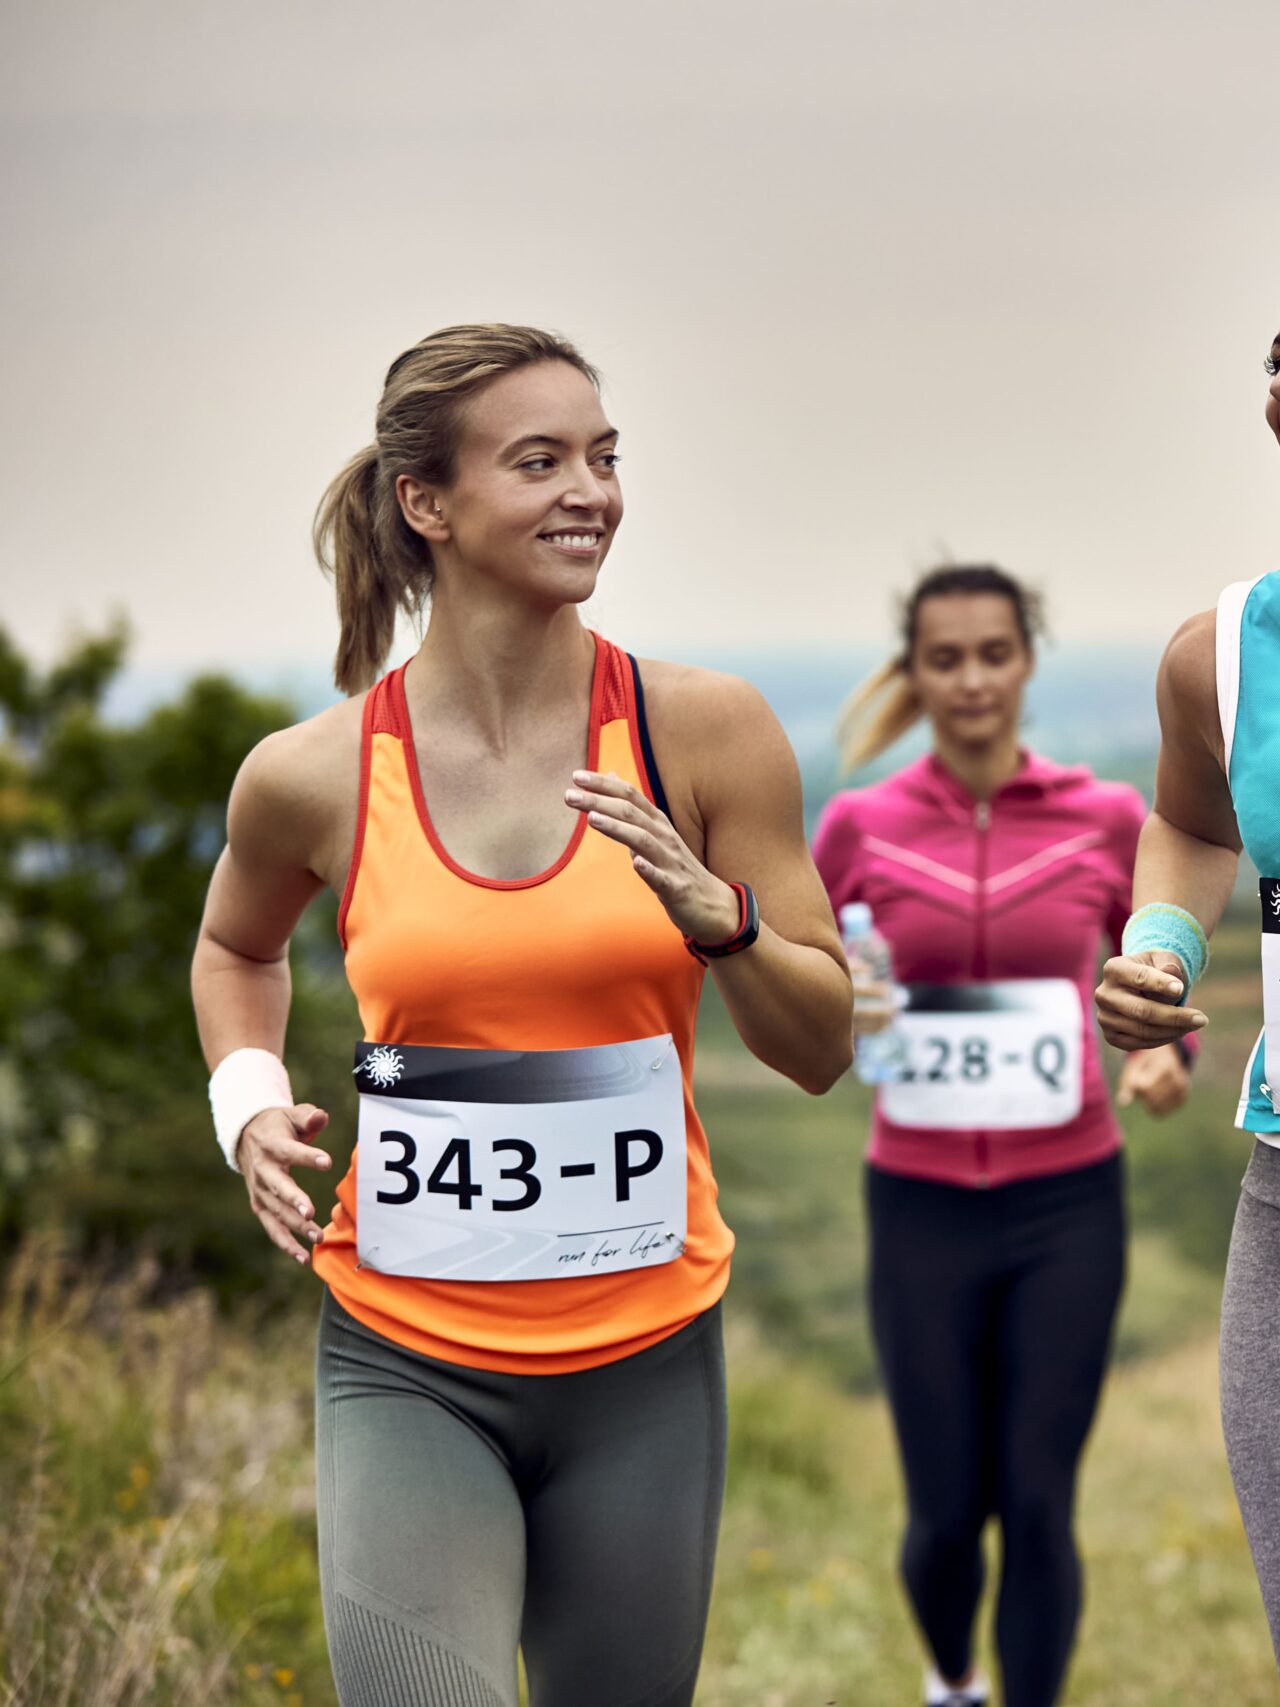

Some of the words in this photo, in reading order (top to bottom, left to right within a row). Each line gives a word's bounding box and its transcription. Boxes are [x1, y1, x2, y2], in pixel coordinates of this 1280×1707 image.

[896, 1035, 1067, 1092] 28-Q
[376, 1129, 664, 1212] 343-P
[558, 1251, 586, 1263] run
[591, 1240, 622, 1266] for
[629, 1230, 665, 1259] life
